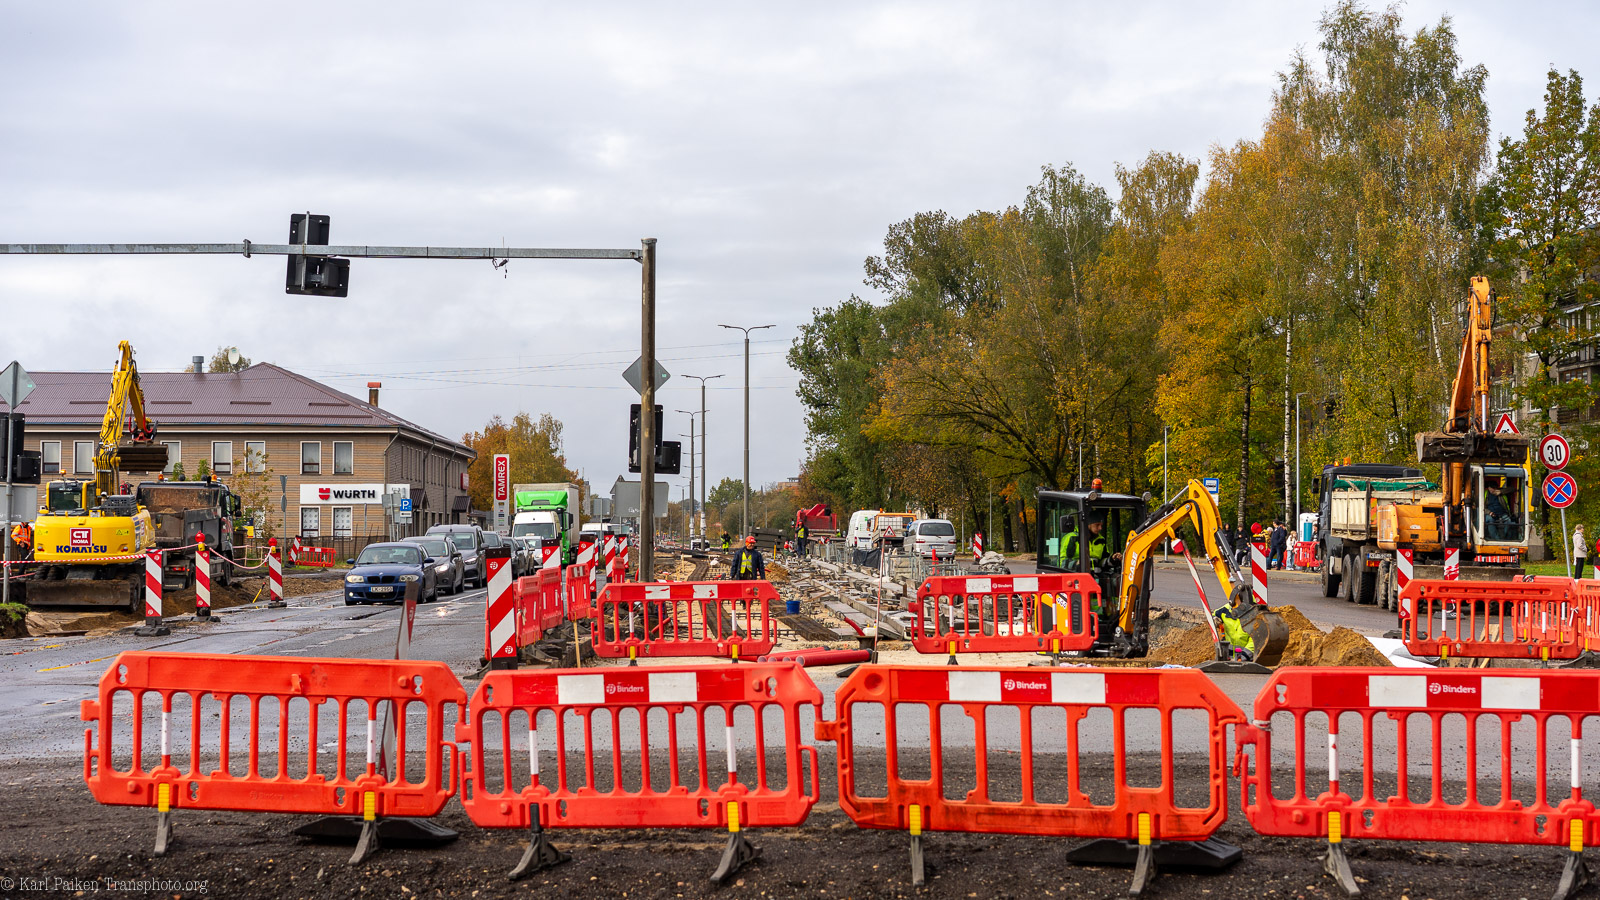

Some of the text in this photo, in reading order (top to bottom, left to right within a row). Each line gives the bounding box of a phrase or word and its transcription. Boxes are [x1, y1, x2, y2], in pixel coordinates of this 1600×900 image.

[1547, 444, 1562, 461] 30
[333, 490, 376, 498] WÜRTH
[56, 544, 108, 553] KOMATSU
[1128, 552, 1138, 582] CASE
[617, 684, 644, 692] Binders
[1016, 680, 1048, 690] Binders
[1442, 684, 1476, 694] Binders
